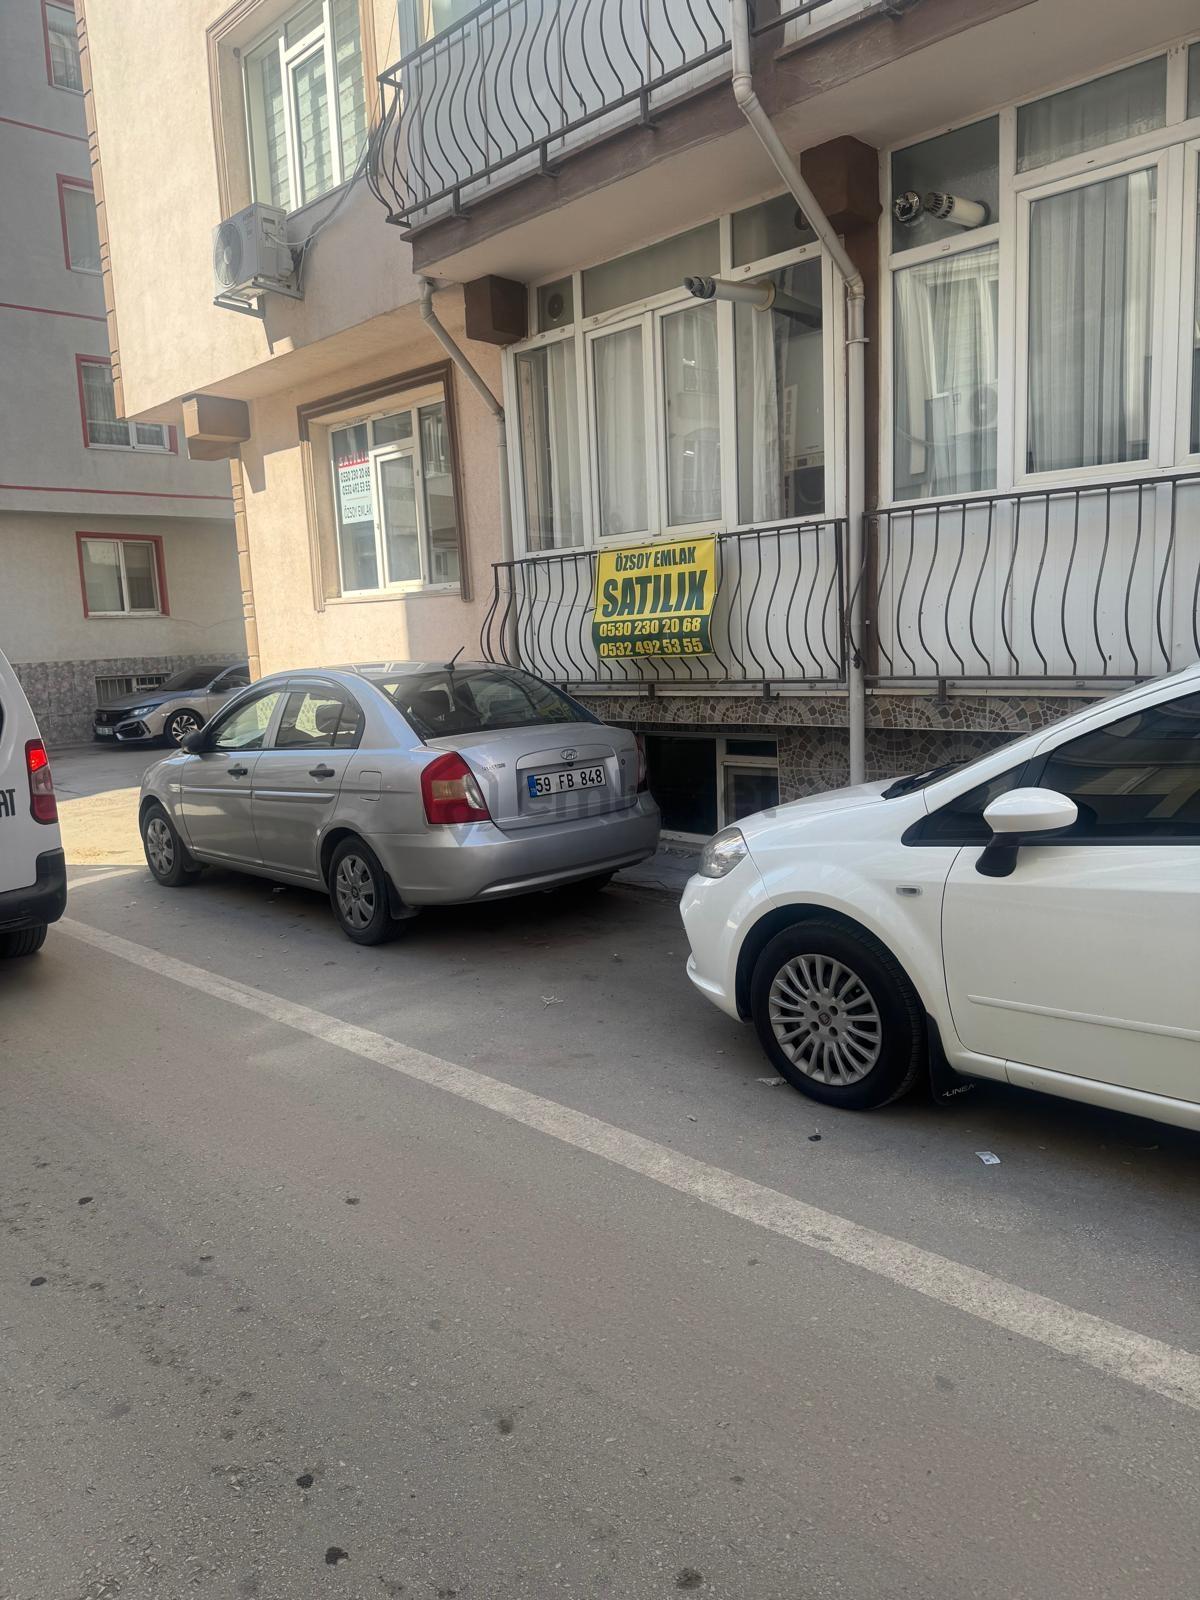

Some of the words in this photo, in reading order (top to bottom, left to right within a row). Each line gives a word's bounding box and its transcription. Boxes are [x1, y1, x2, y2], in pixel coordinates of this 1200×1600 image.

[615, 552, 652, 572] ÖZSOY
[654, 546, 696, 568] EMLAK
[602, 570, 708, 617] SATILIK
[600, 622, 632, 637] 0530
[634, 620, 659, 635] 230
[662, 618, 680, 633] 20
[683, 617, 701, 632] 68
[600, 642, 633, 656] 0532
[636, 640, 661, 655] 492
[663, 638, 681, 653] 53
[683, 637, 703, 652] 55
[535, 777, 551, 793] 59
[558, 773, 574, 789] FB
[580, 769, 603, 785] 848
